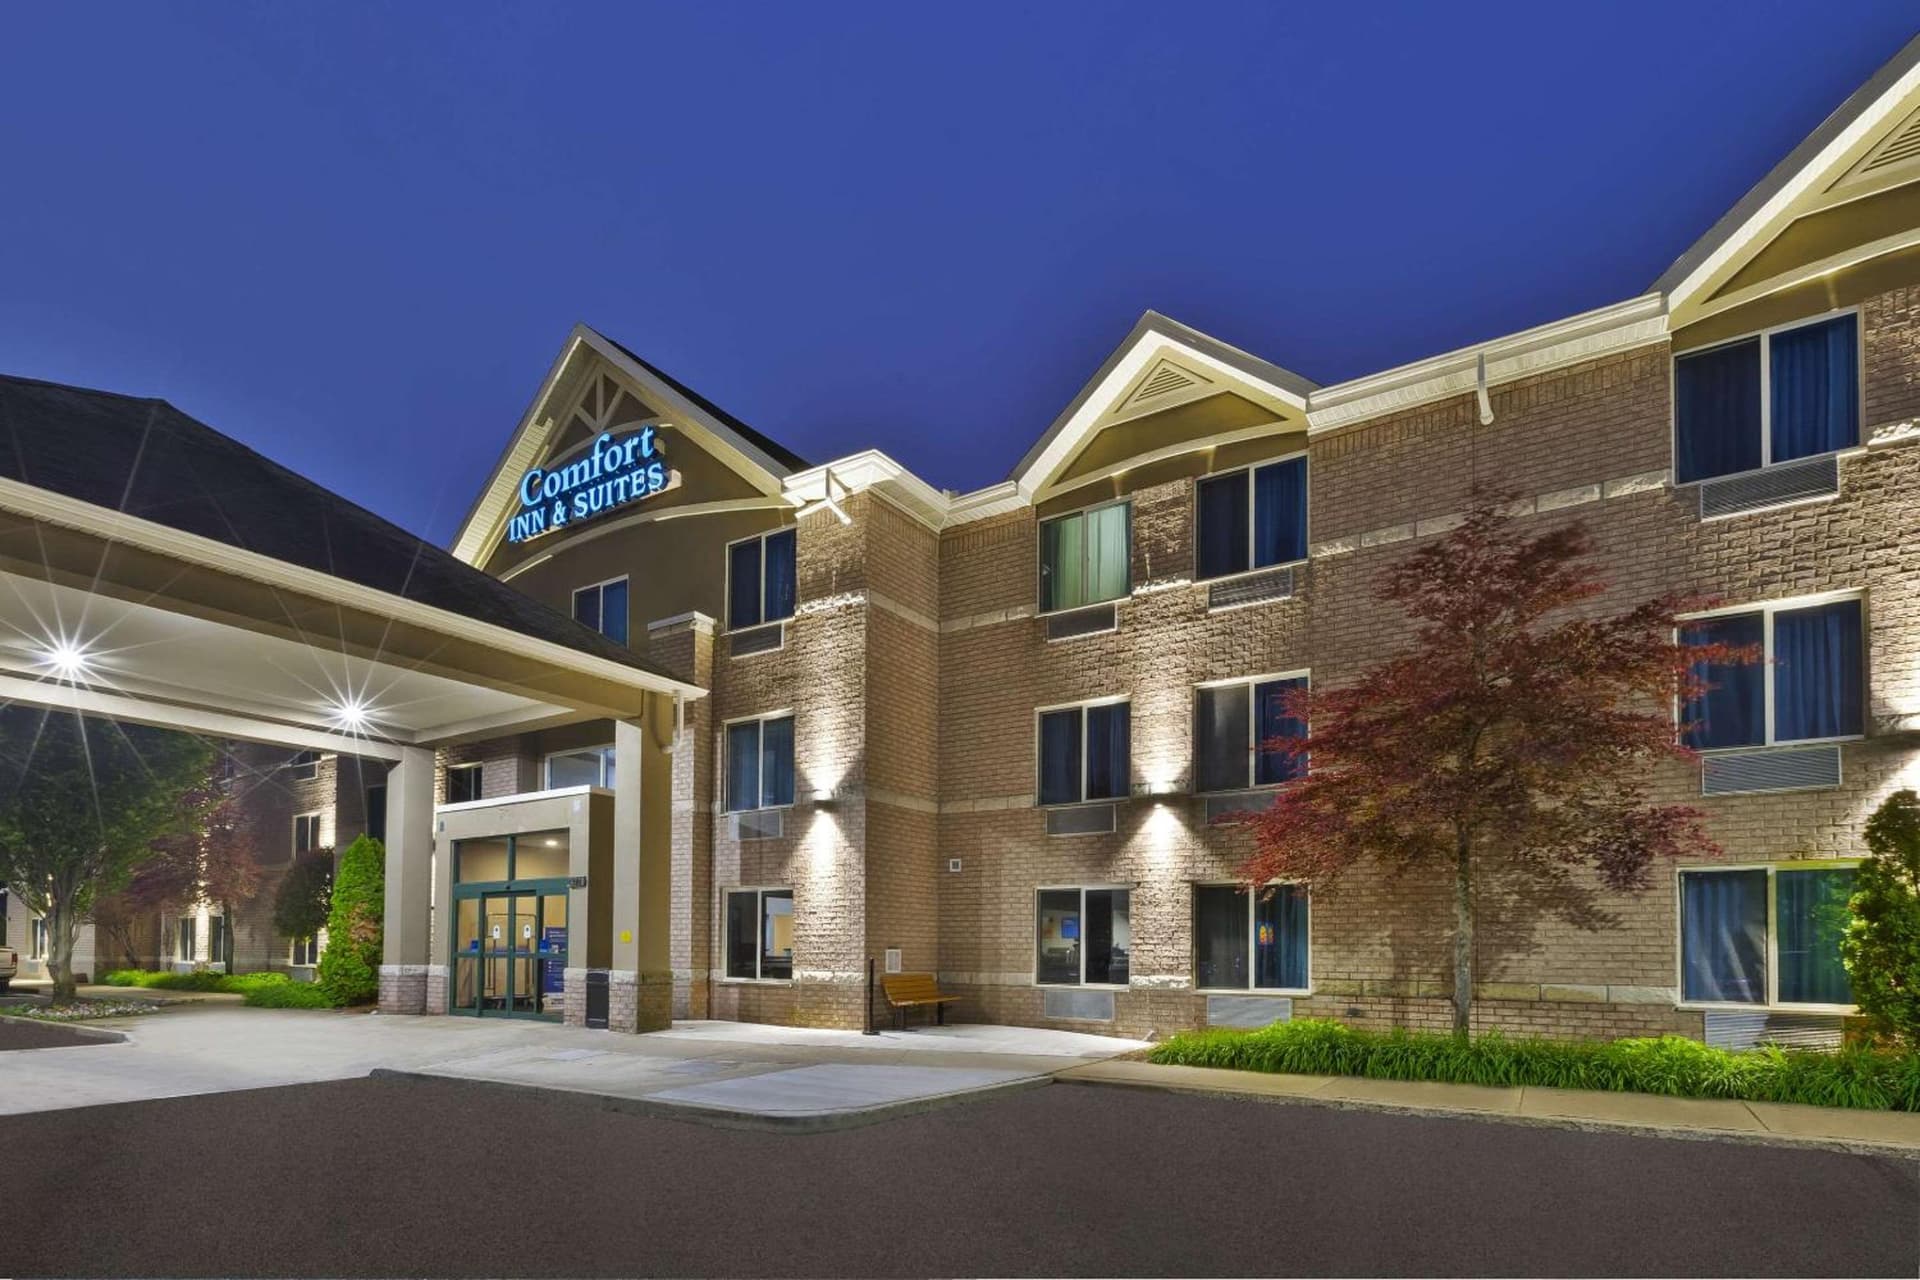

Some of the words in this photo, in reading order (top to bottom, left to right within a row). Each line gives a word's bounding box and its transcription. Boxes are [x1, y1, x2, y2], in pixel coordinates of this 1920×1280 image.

[508, 507, 546, 542] INN
[553, 500, 567, 525] &
[575, 462, 664, 517] SUITES
[521, 426, 654, 506] Comfort
